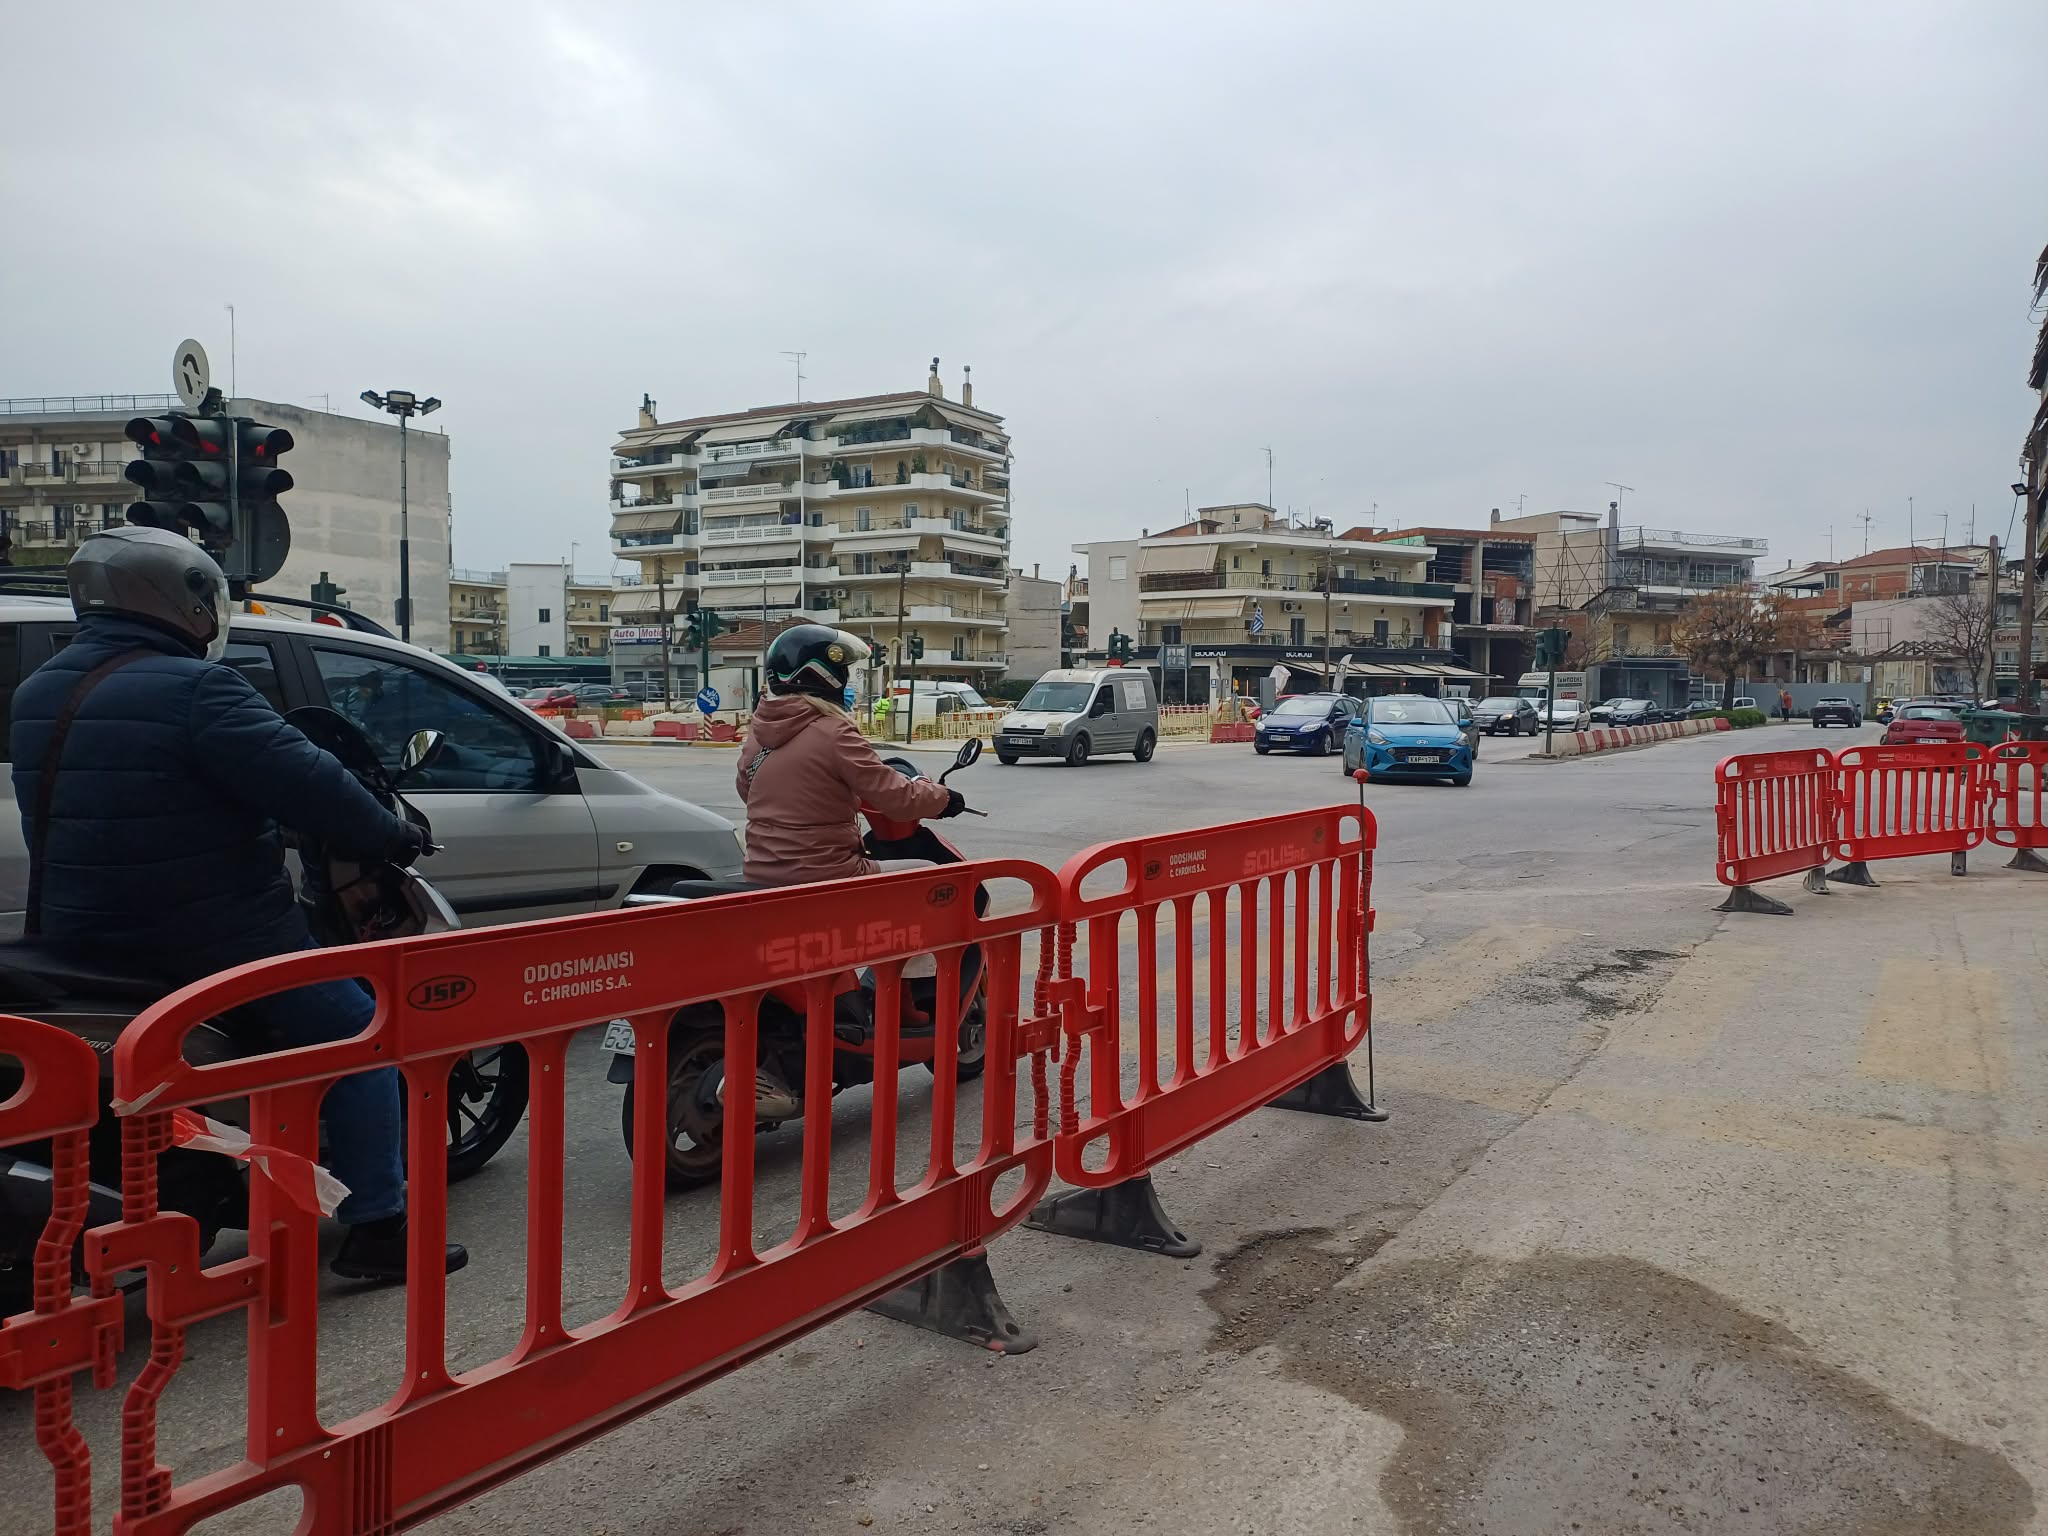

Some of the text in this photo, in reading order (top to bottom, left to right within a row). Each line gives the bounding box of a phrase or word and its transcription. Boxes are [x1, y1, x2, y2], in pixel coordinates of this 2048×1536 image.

[614, 629, 635, 637] Auto
[1169, 849, 1207, 865] ODOSIMANSI
[933, 885, 954, 903] JSP
[523, 949, 634, 985] ODOSIMANSI
[417, 980, 467, 1005] JSP
[523, 974, 632, 1006] C. CHRONIS S.A.
